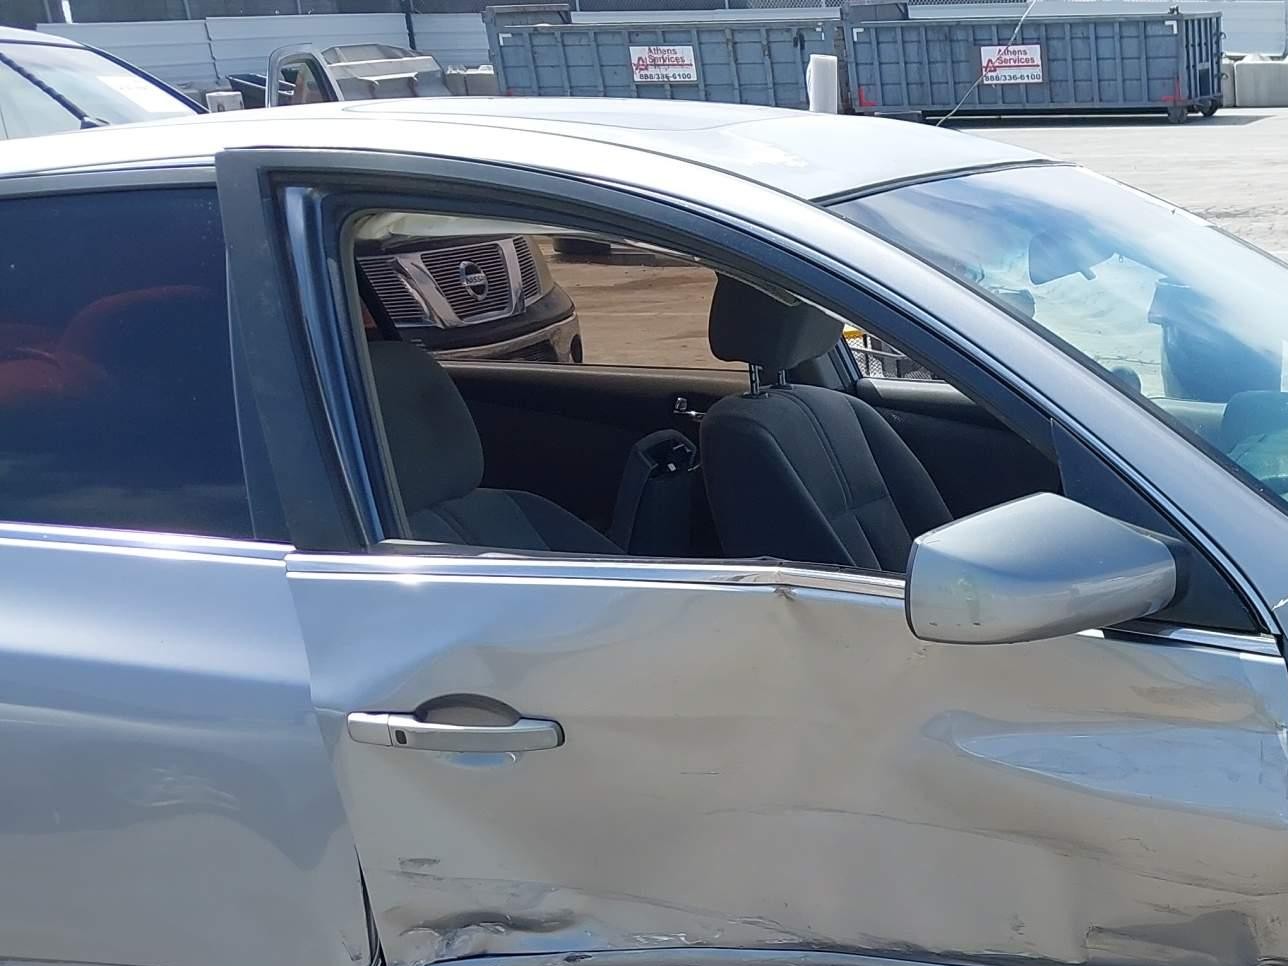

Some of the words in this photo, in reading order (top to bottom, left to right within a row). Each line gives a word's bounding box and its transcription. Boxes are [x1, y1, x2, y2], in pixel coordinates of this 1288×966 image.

[647, 47, 677, 55] Athens
[998, 48, 1027, 56] Athens
[647, 55, 686, 63] Services
[997, 57, 1035, 65] Services
[984, 73, 1041, 82] 888/336-6100
